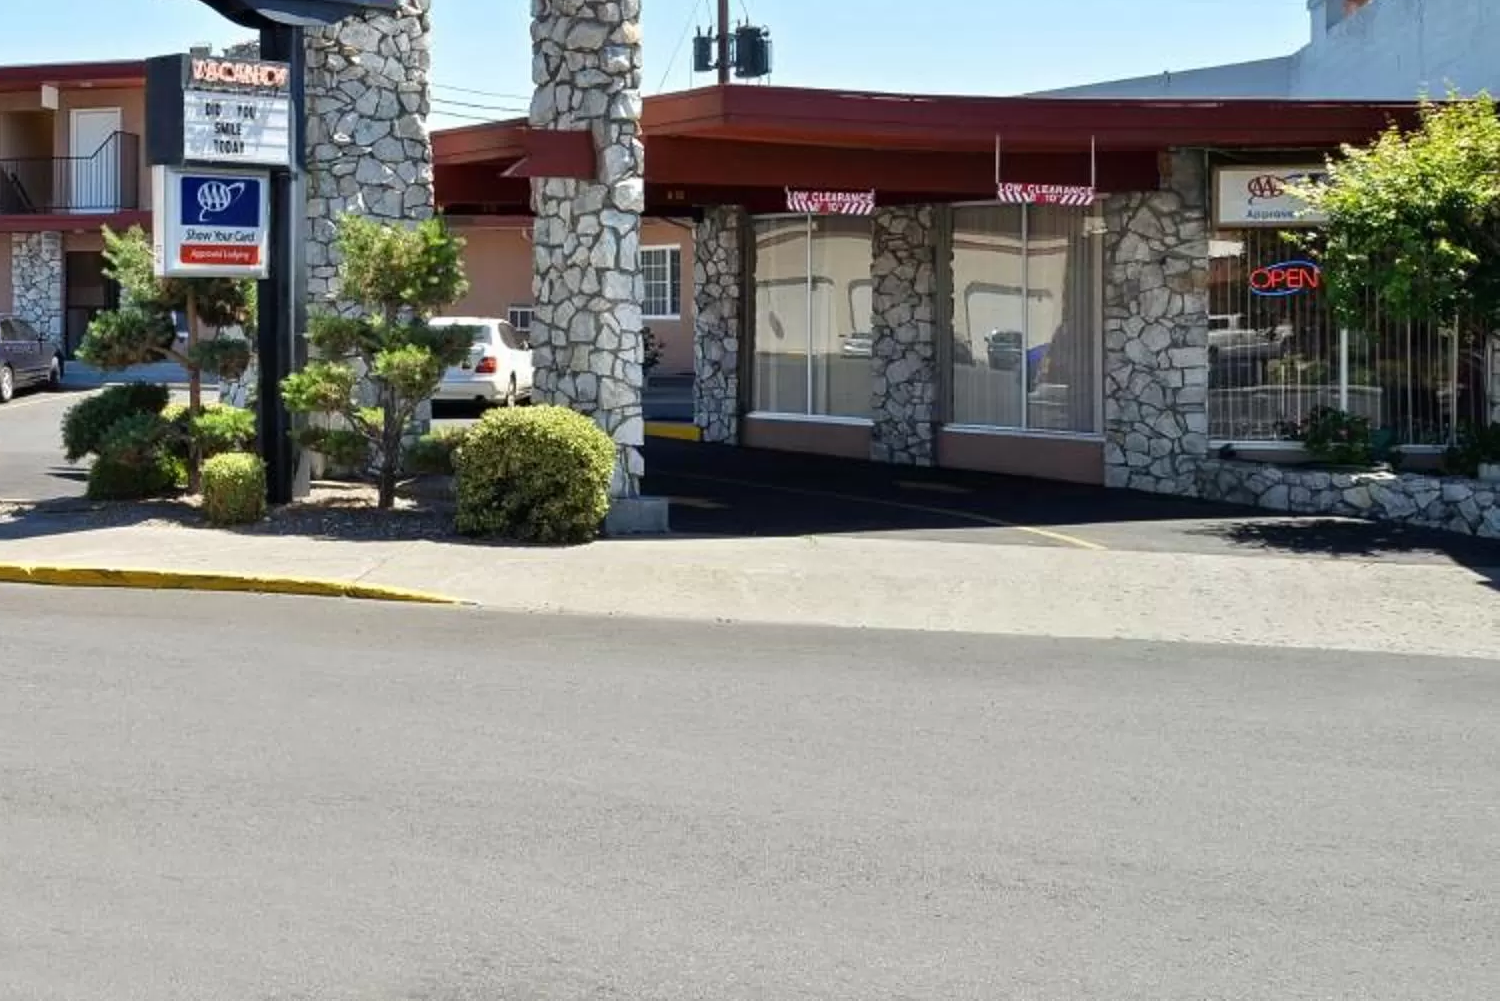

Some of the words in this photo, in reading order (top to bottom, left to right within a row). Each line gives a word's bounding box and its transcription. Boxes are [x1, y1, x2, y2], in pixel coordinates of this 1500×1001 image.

[214, 122, 241, 136] SMILE
[213, 139, 245, 154] TODAY
[998, 182, 1023, 192] LOW
[1027, 184, 1094, 196] CLEARANCE
[812, 191, 874, 203] CLEARANCE
[186, 228, 212, 242] Show
[213, 230, 234, 242] Your
[235, 230, 256, 242] Card
[1251, 267, 1320, 289] OPEN
